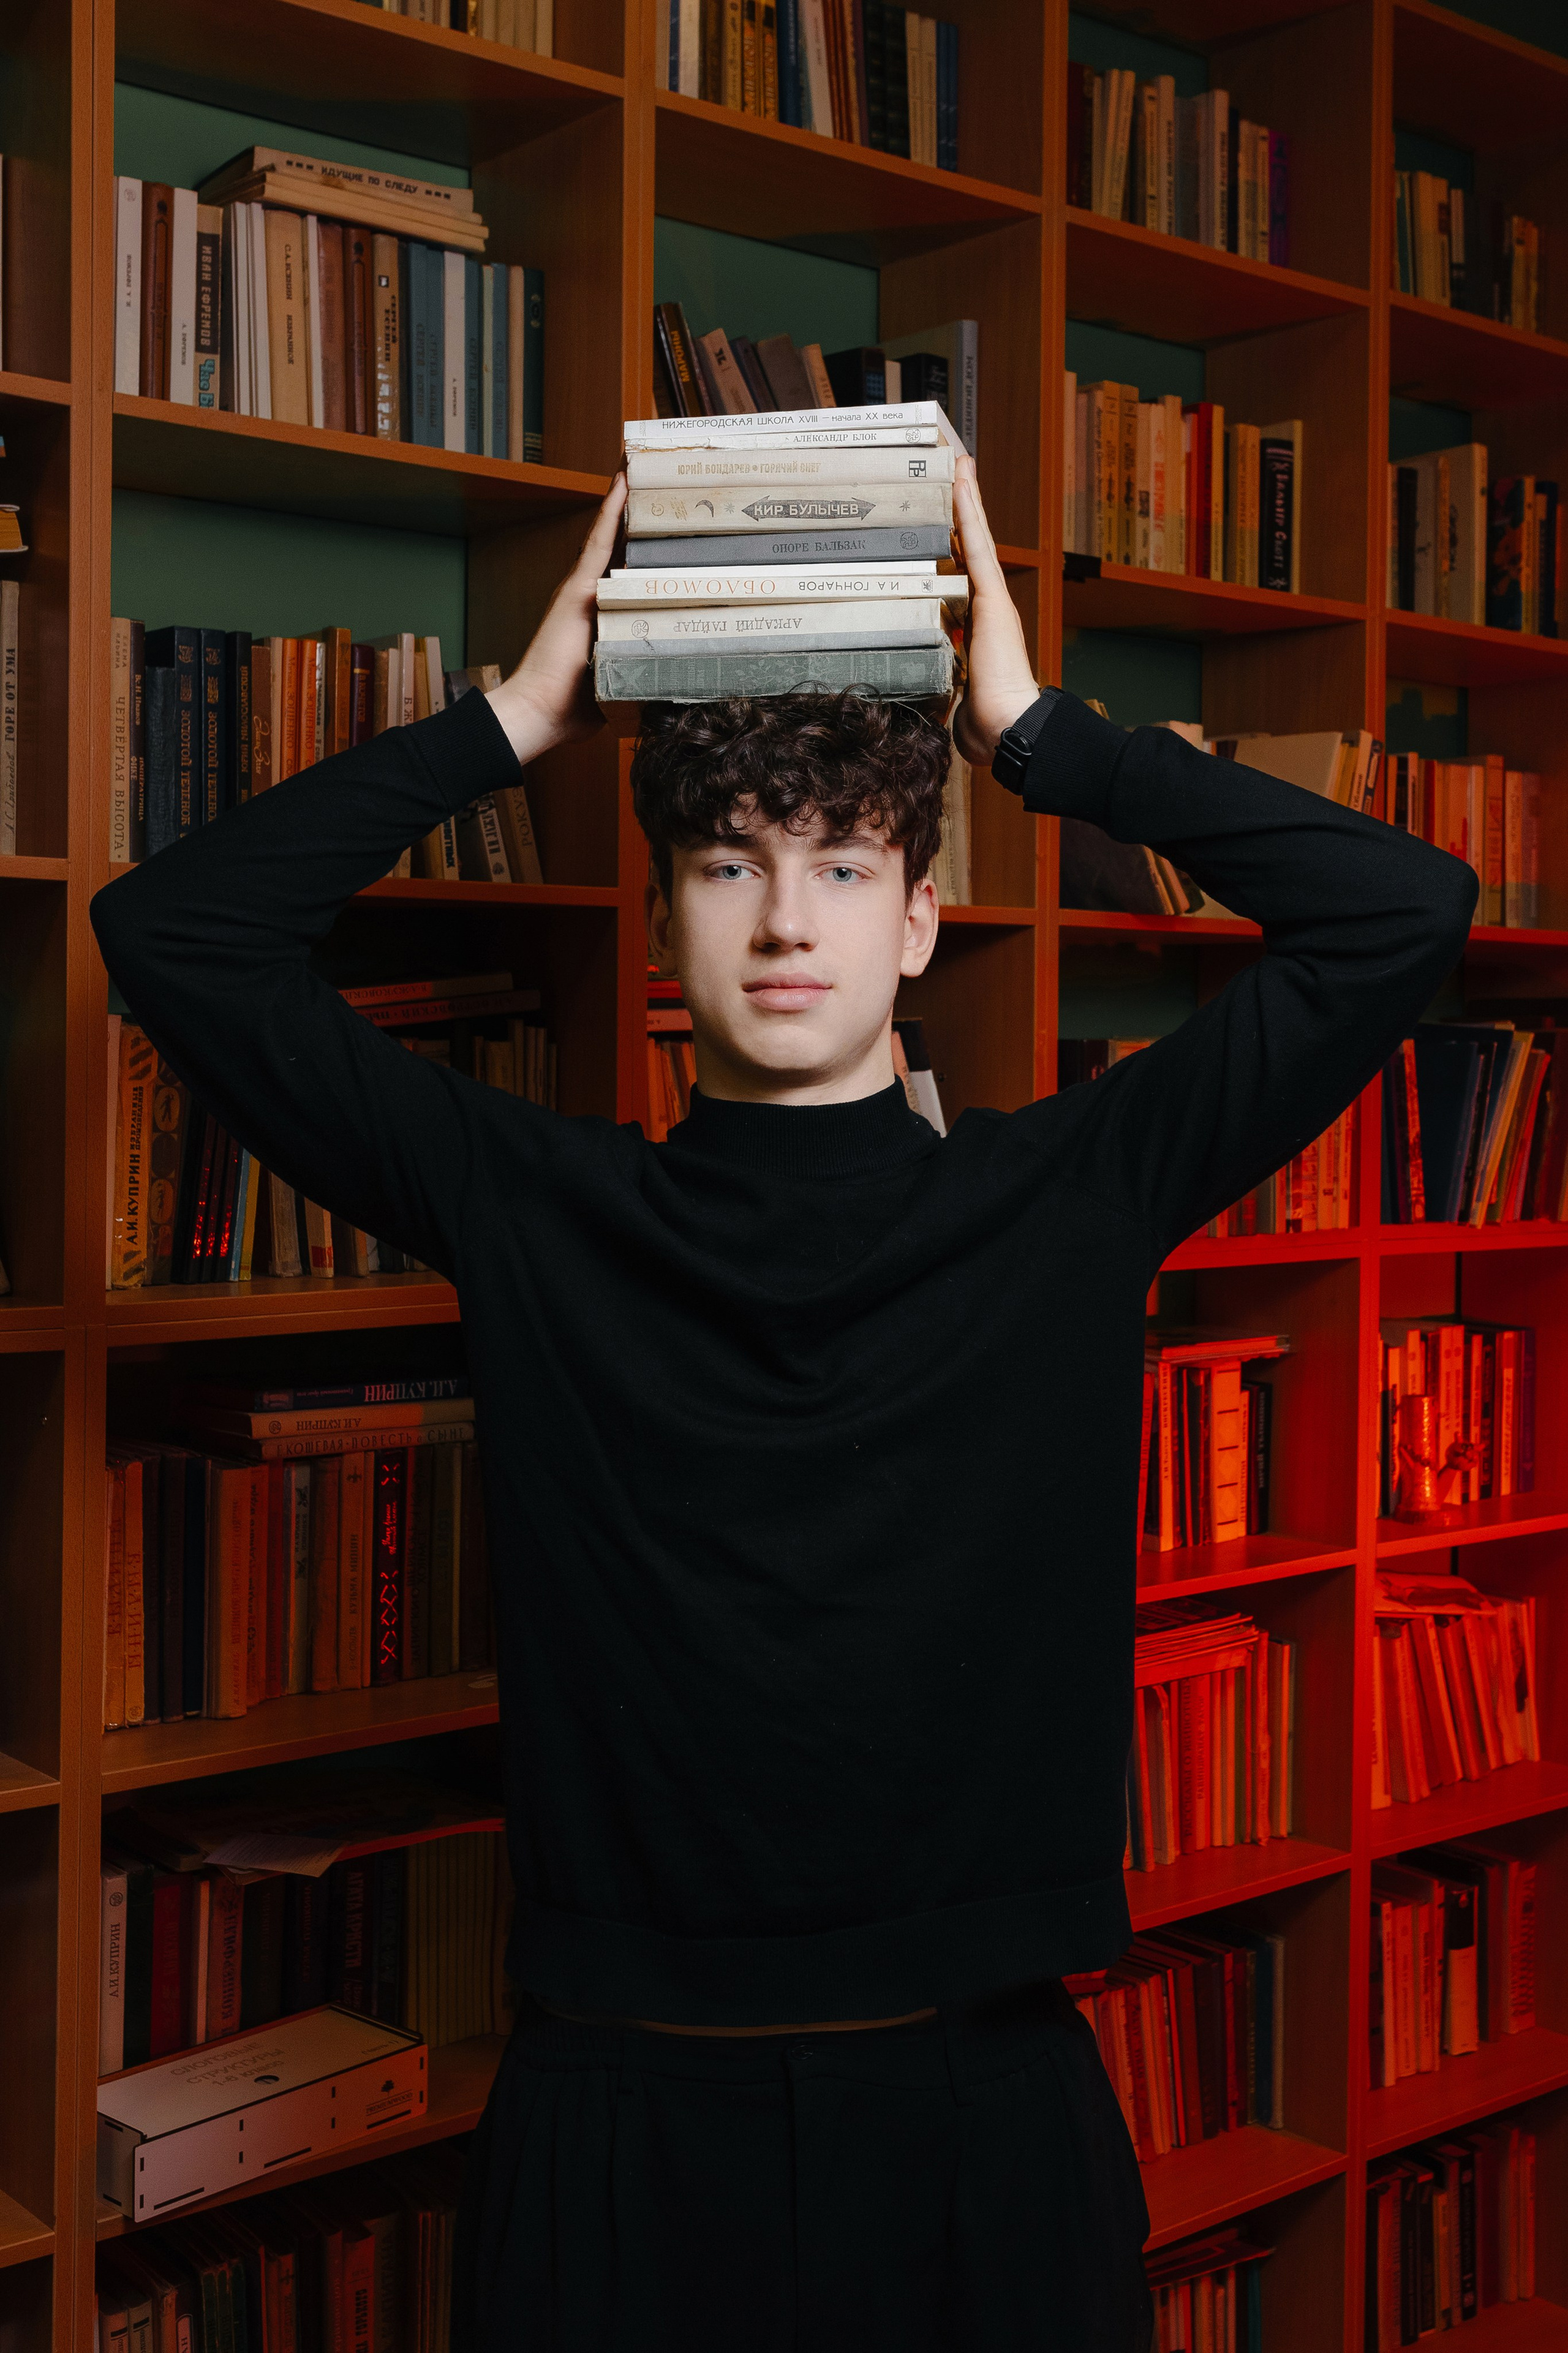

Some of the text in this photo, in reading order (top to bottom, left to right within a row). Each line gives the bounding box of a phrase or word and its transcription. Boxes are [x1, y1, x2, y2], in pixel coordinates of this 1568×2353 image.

[320, 166, 419, 194] ИДУЩИЕ ПО СЛЕДУ
[200, 246, 213, 347] ИВАН ЕФРЕМОВ
[198, 359, 215, 391] Час
[662, 416, 753, 430] НИЖЕГОРОДСКАЯ
[756, 415, 794, 426] ШКОЛА
[798, 414, 819, 424] XVIII
[831, 413, 862, 422] начала
[793, 432, 877, 443] АЛЕКСАНДР БЛОК
[678, 461, 703, 475] ЮРИЙ
[705, 461, 750, 475] БОНДАРЕВ
[760, 461, 797, 475] ГОРЯЧИЙ
[754, 502, 859, 517] КИР БУЛЫЧЕВ
[815, 540, 866, 553] БАЛЬЗАК
[645, 579, 775, 595] ОБЛОМОВ
[799, 580, 870, 592] ГОНЧАРОВ
[674, 618, 802, 633] АРКАДИЙ ГАЙДАР
[5, 648, 15, 675] УМА
[5, 682, 15, 701] ОТ
[5, 707, 15, 742] ГОРЕ
[207, 711, 219, 768] ЗОЛОТОЙ
[113, 695, 129, 851] ЧЕТВЁРТАЯ ВЫСОТА
[180, 709, 192, 826] ЗОЛОТОЙ ТЕЛЕНОК
[511, 787, 532, 847] РОКУЭ
[443, 820, 455, 868] ИВОТНЫХ
[345, 986, 410, 1000] ЖУКОВСКИ
[366, 1011, 391, 1021] ПЬЕ
[135, 1086, 144, 1150] ПРОИЗВЕДЕНИЯ
[126, 1154, 141, 1245] А.И. КУПРИН
[363, 1378, 458, 1402] А.И. КУПРИН
[286, 1439, 344, 1456] КОШЕВАЯ
[352, 1433, 412, 1449] ПОВЕСТЬ
[428, 1427, 466, 1443] СЫНЕ
[296, 1419, 342, 1432] КУПРИН
[1256, 1453, 1265, 1488] ЮРИЙ
[350, 1534, 358, 1572] МИНИН
[411, 1601, 421, 1663] ЗАПИСКИ
[1183, 1678, 1192, 1751] ЖИВОТНЫХ
[345, 1872, 364, 1911] АГАТА
[110, 1922, 121, 1975] КУПРИН
[345, 1913, 363, 1968] КРИСТИ
[170, 2042, 260, 2077] СЛОГОВЫЕ
[186, 2048, 286, 2085] СТРУКТУРЫ
[355, 2289, 368, 2336] ГОРЬКОГО
